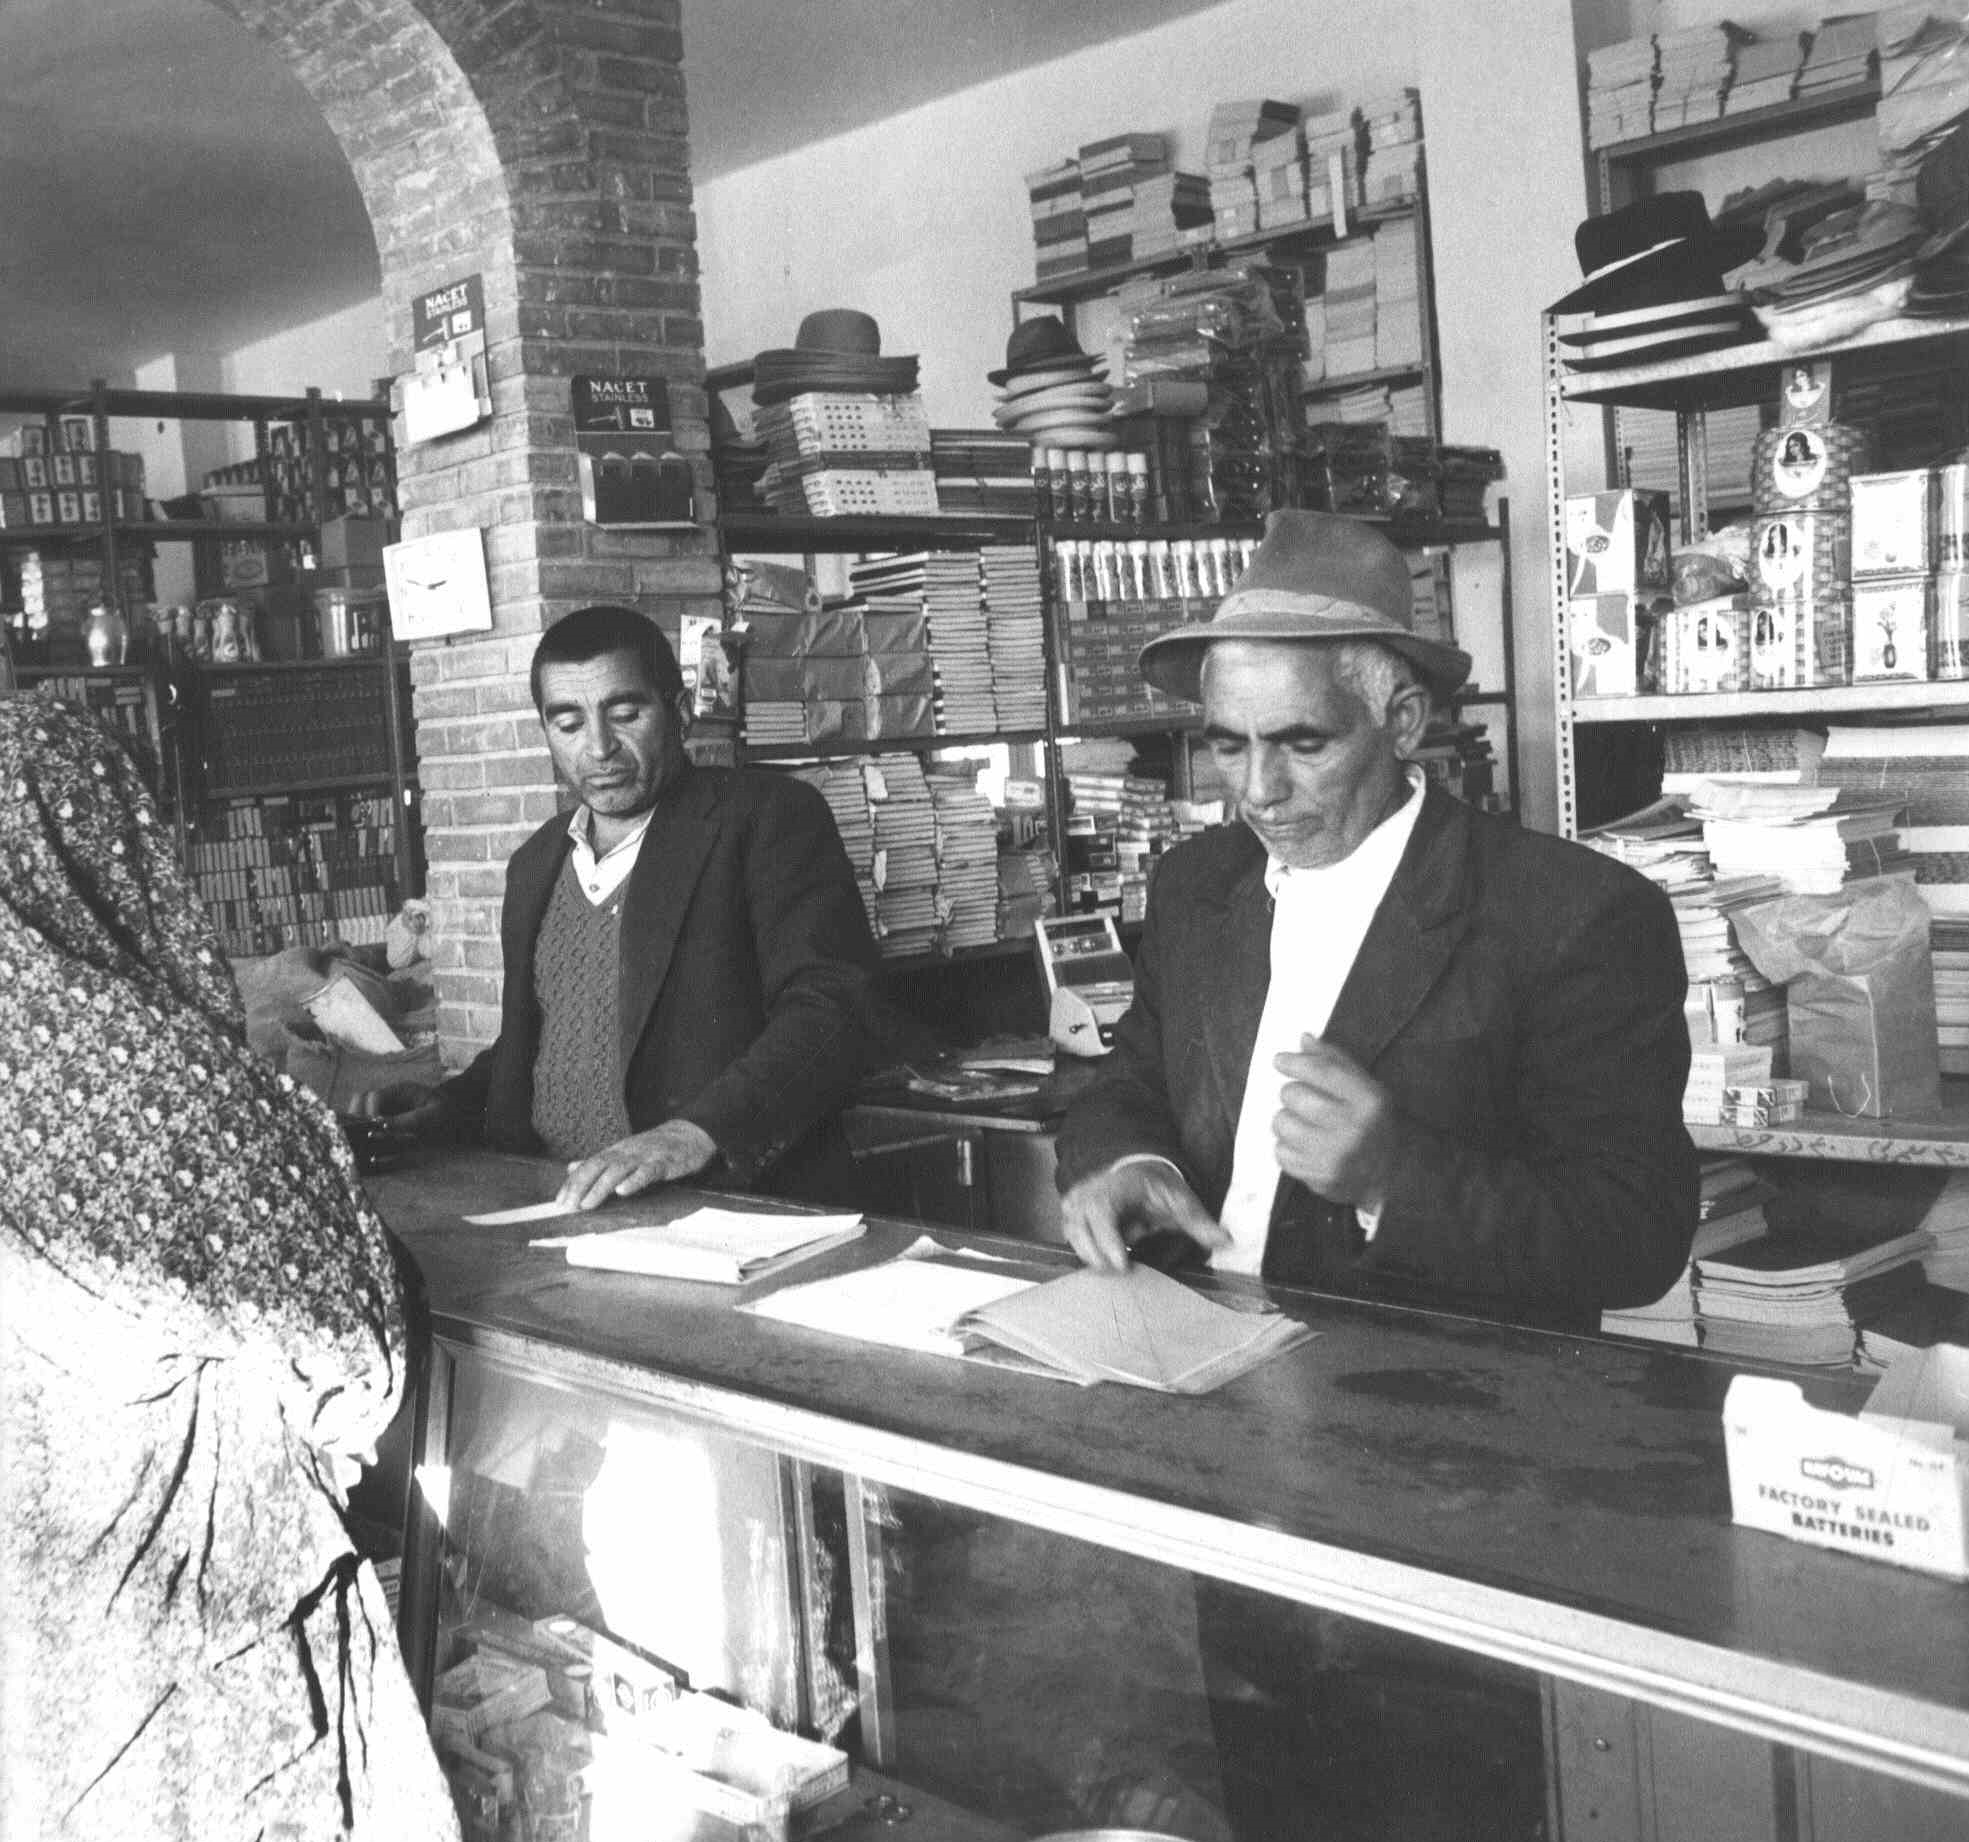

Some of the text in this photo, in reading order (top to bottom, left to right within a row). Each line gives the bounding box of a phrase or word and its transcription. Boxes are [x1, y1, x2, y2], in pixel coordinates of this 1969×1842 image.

[590, 380, 648, 393] NACET
[1758, 1484, 1930, 1532] FACTORY SEALED
[1792, 1512, 1894, 1545] BATTERIES
